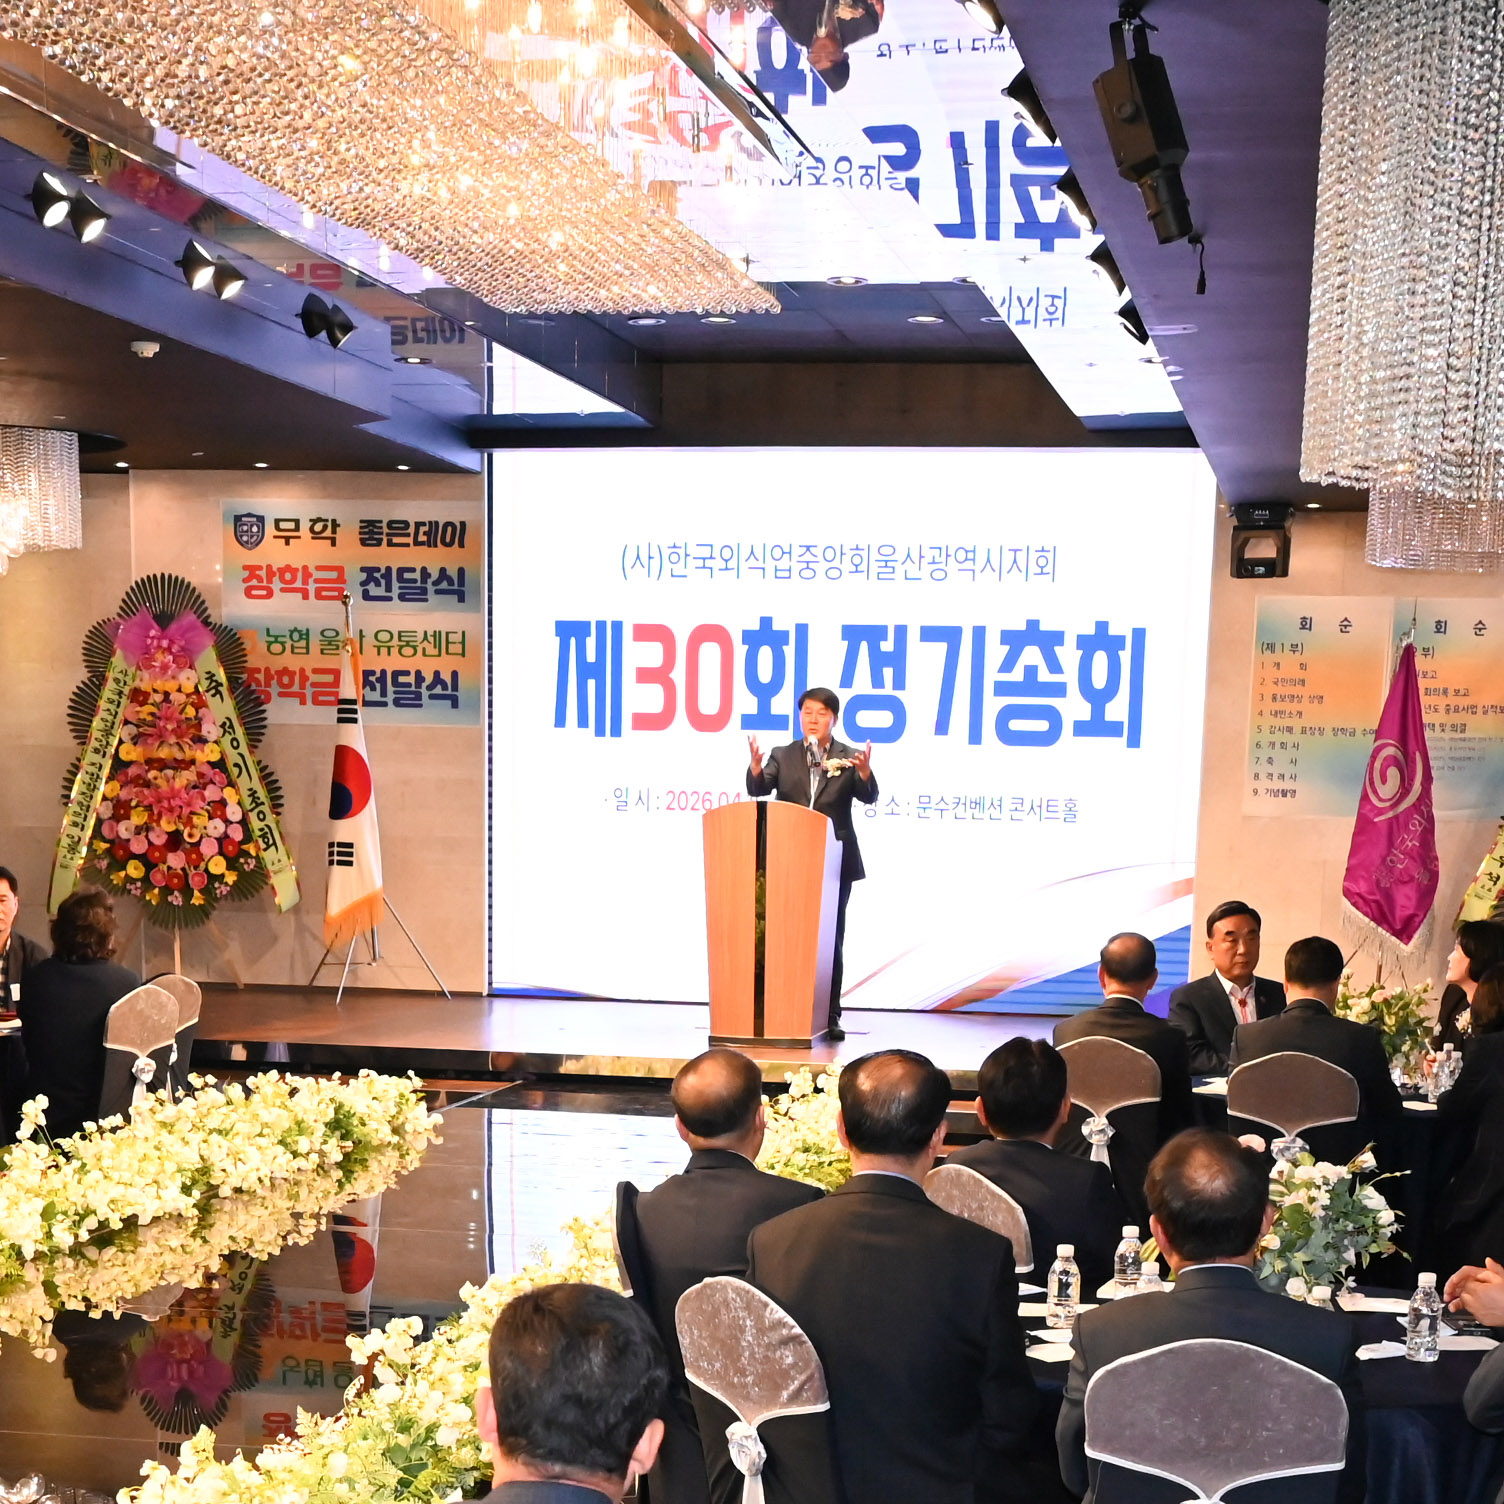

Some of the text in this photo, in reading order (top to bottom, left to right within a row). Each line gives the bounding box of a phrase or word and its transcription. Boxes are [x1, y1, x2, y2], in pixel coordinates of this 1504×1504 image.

[358, 519, 467, 548] 좋은데이
[621, 542, 1057, 583] (사)한국외식업중앙회울산광역시지회
[241, 563, 466, 604] 장학금 전달식
[265, 627, 466, 658] 농협 울 유통센터
[245, 666, 459, 709] 장학금 전달식
[554, 616, 1147, 749] 제30회 정기총회
[204, 670, 279, 855] 축 정기총회
[916, 795, 1003, 821] 문수컨벤션
[1008, 797, 1079, 824] 콘서트홀
